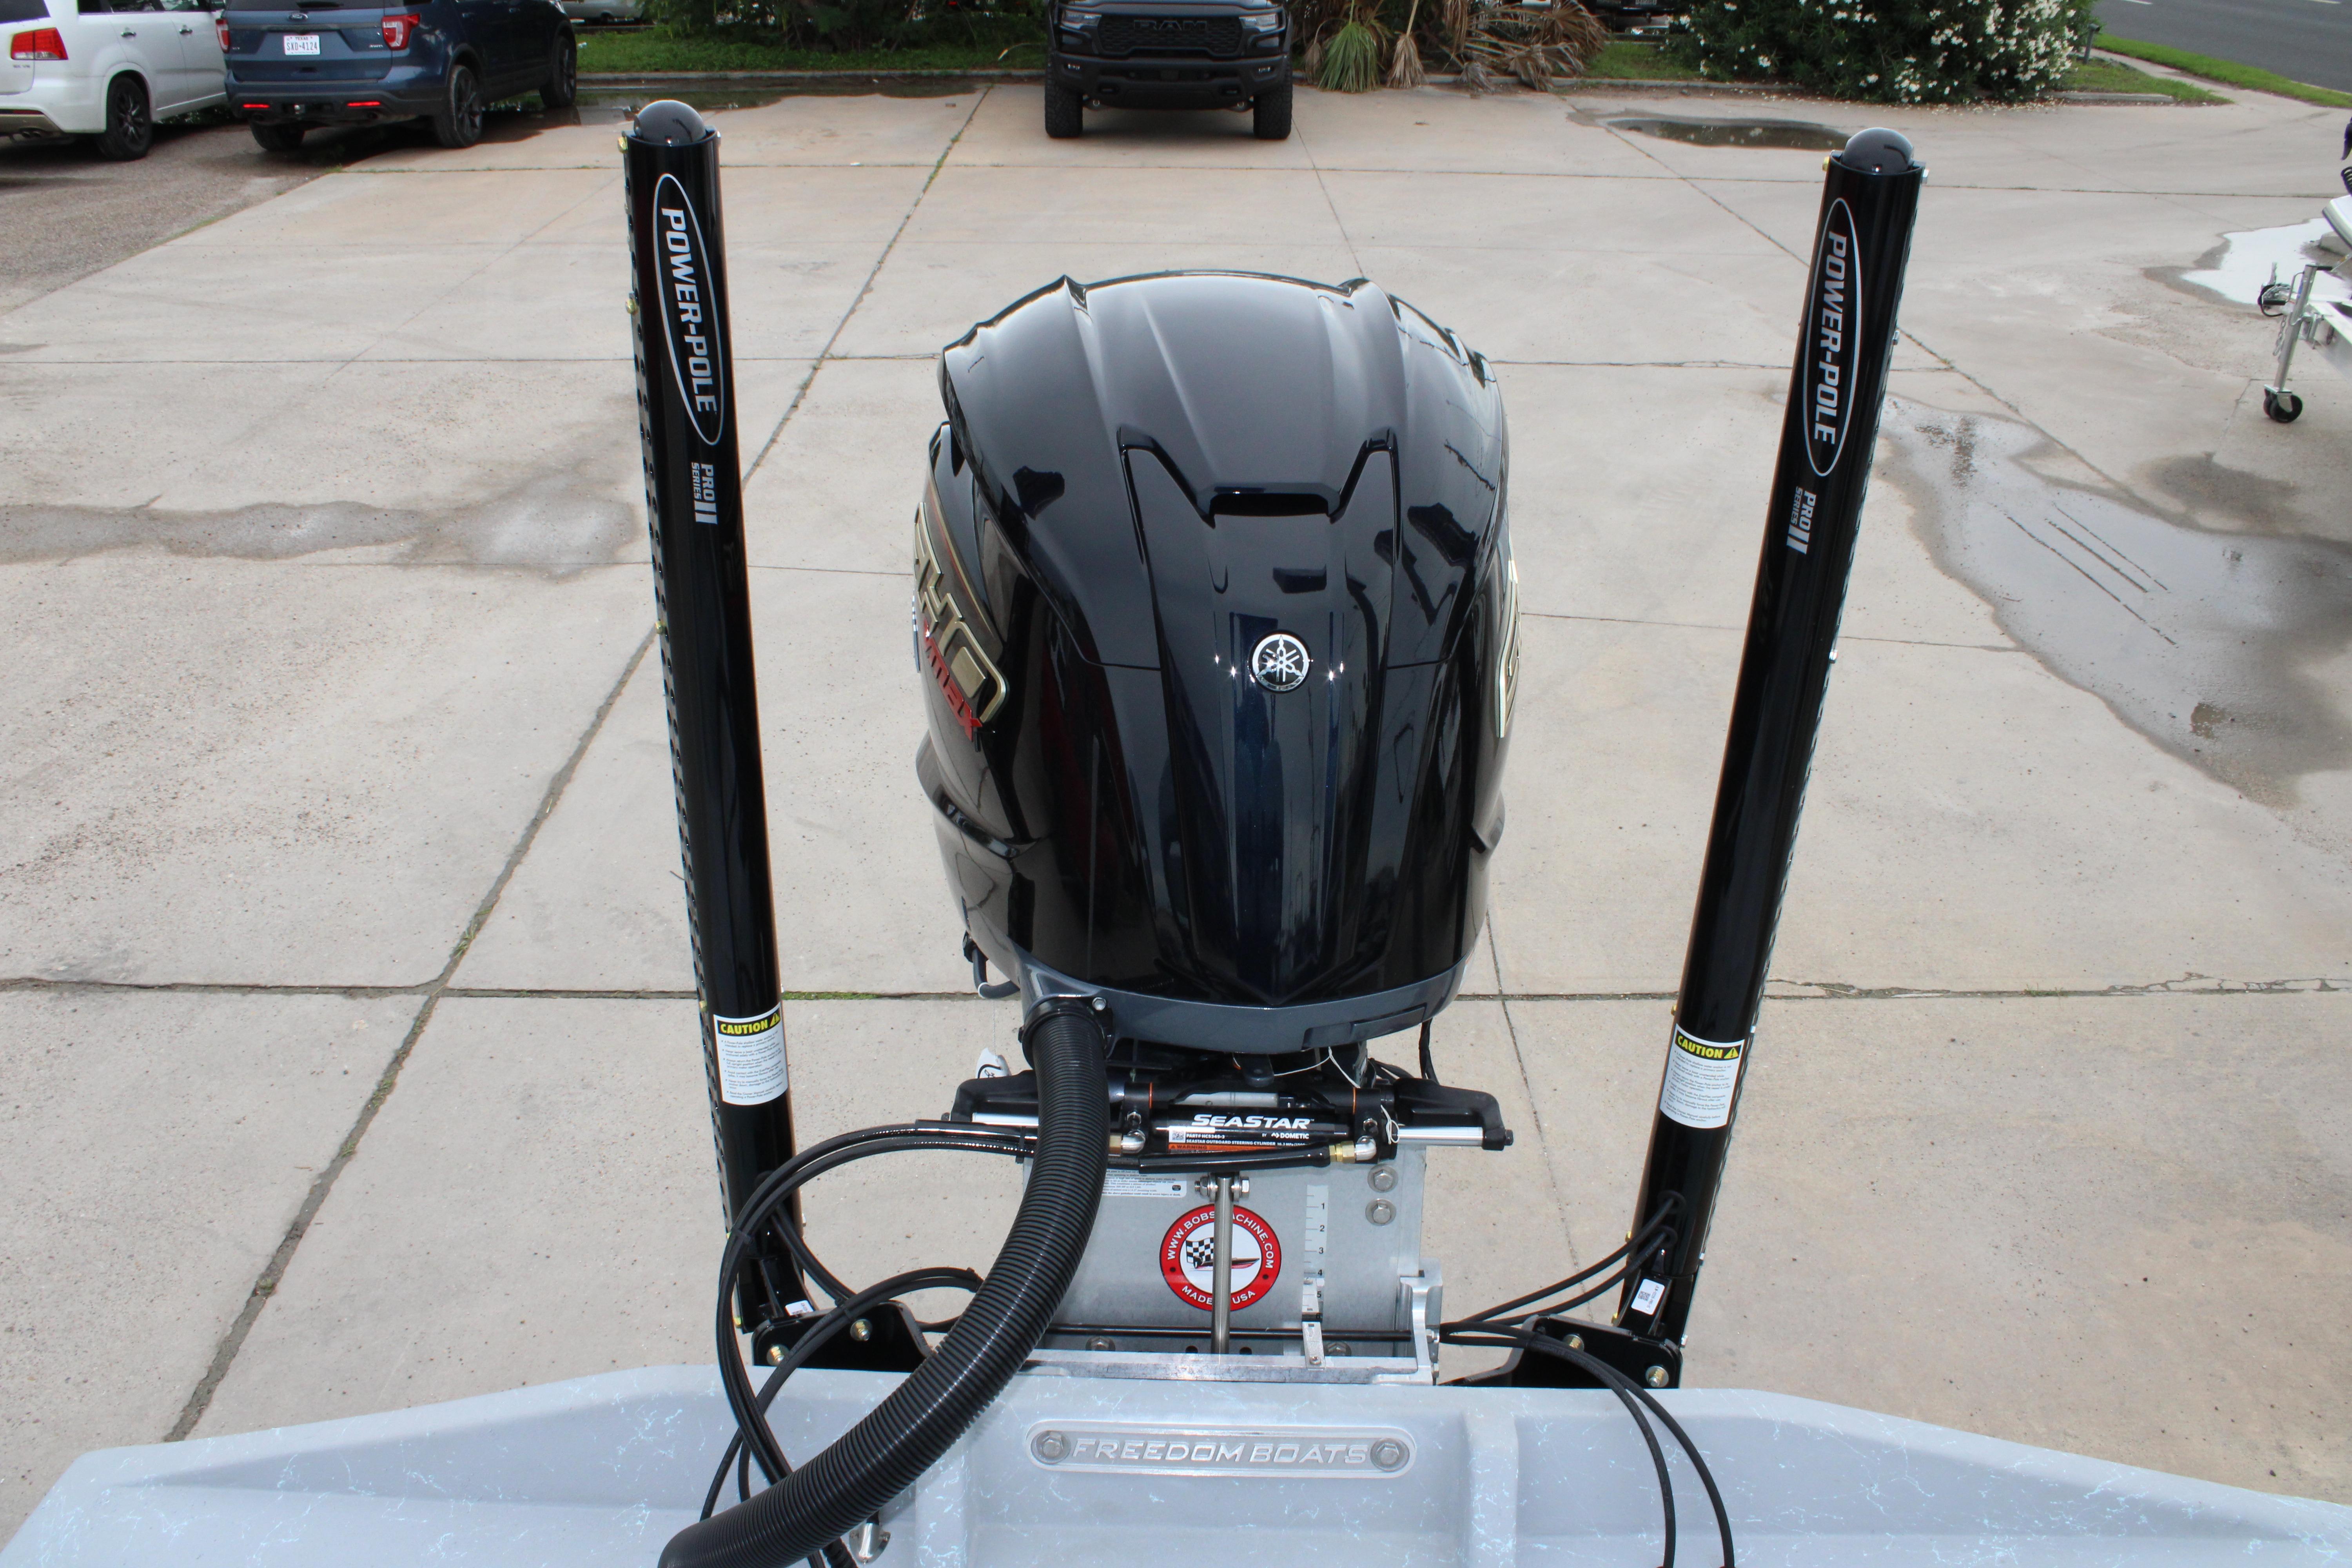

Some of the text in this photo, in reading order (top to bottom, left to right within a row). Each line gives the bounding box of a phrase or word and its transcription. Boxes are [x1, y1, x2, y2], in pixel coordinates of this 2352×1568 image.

[1134, 20, 1208, 31] RAM
[661, 208, 717, 412] POWER-POLE
[1814, 231, 1847, 445] POWER-POLE
[691, 462, 702, 500] SERIES
[700, 463, 715, 501] PRO
[1789, 486, 1803, 525] SERIES
[1798, 490, 1817, 531] PRO
[720, 1019, 768, 1034] CAUTION
[1677, 1035, 1724, 1058] CAUTION
[1181, 1285, 1256, 1305] MADE USA
[1072, 1438, 1368, 1464] FREEDOM BOATS
